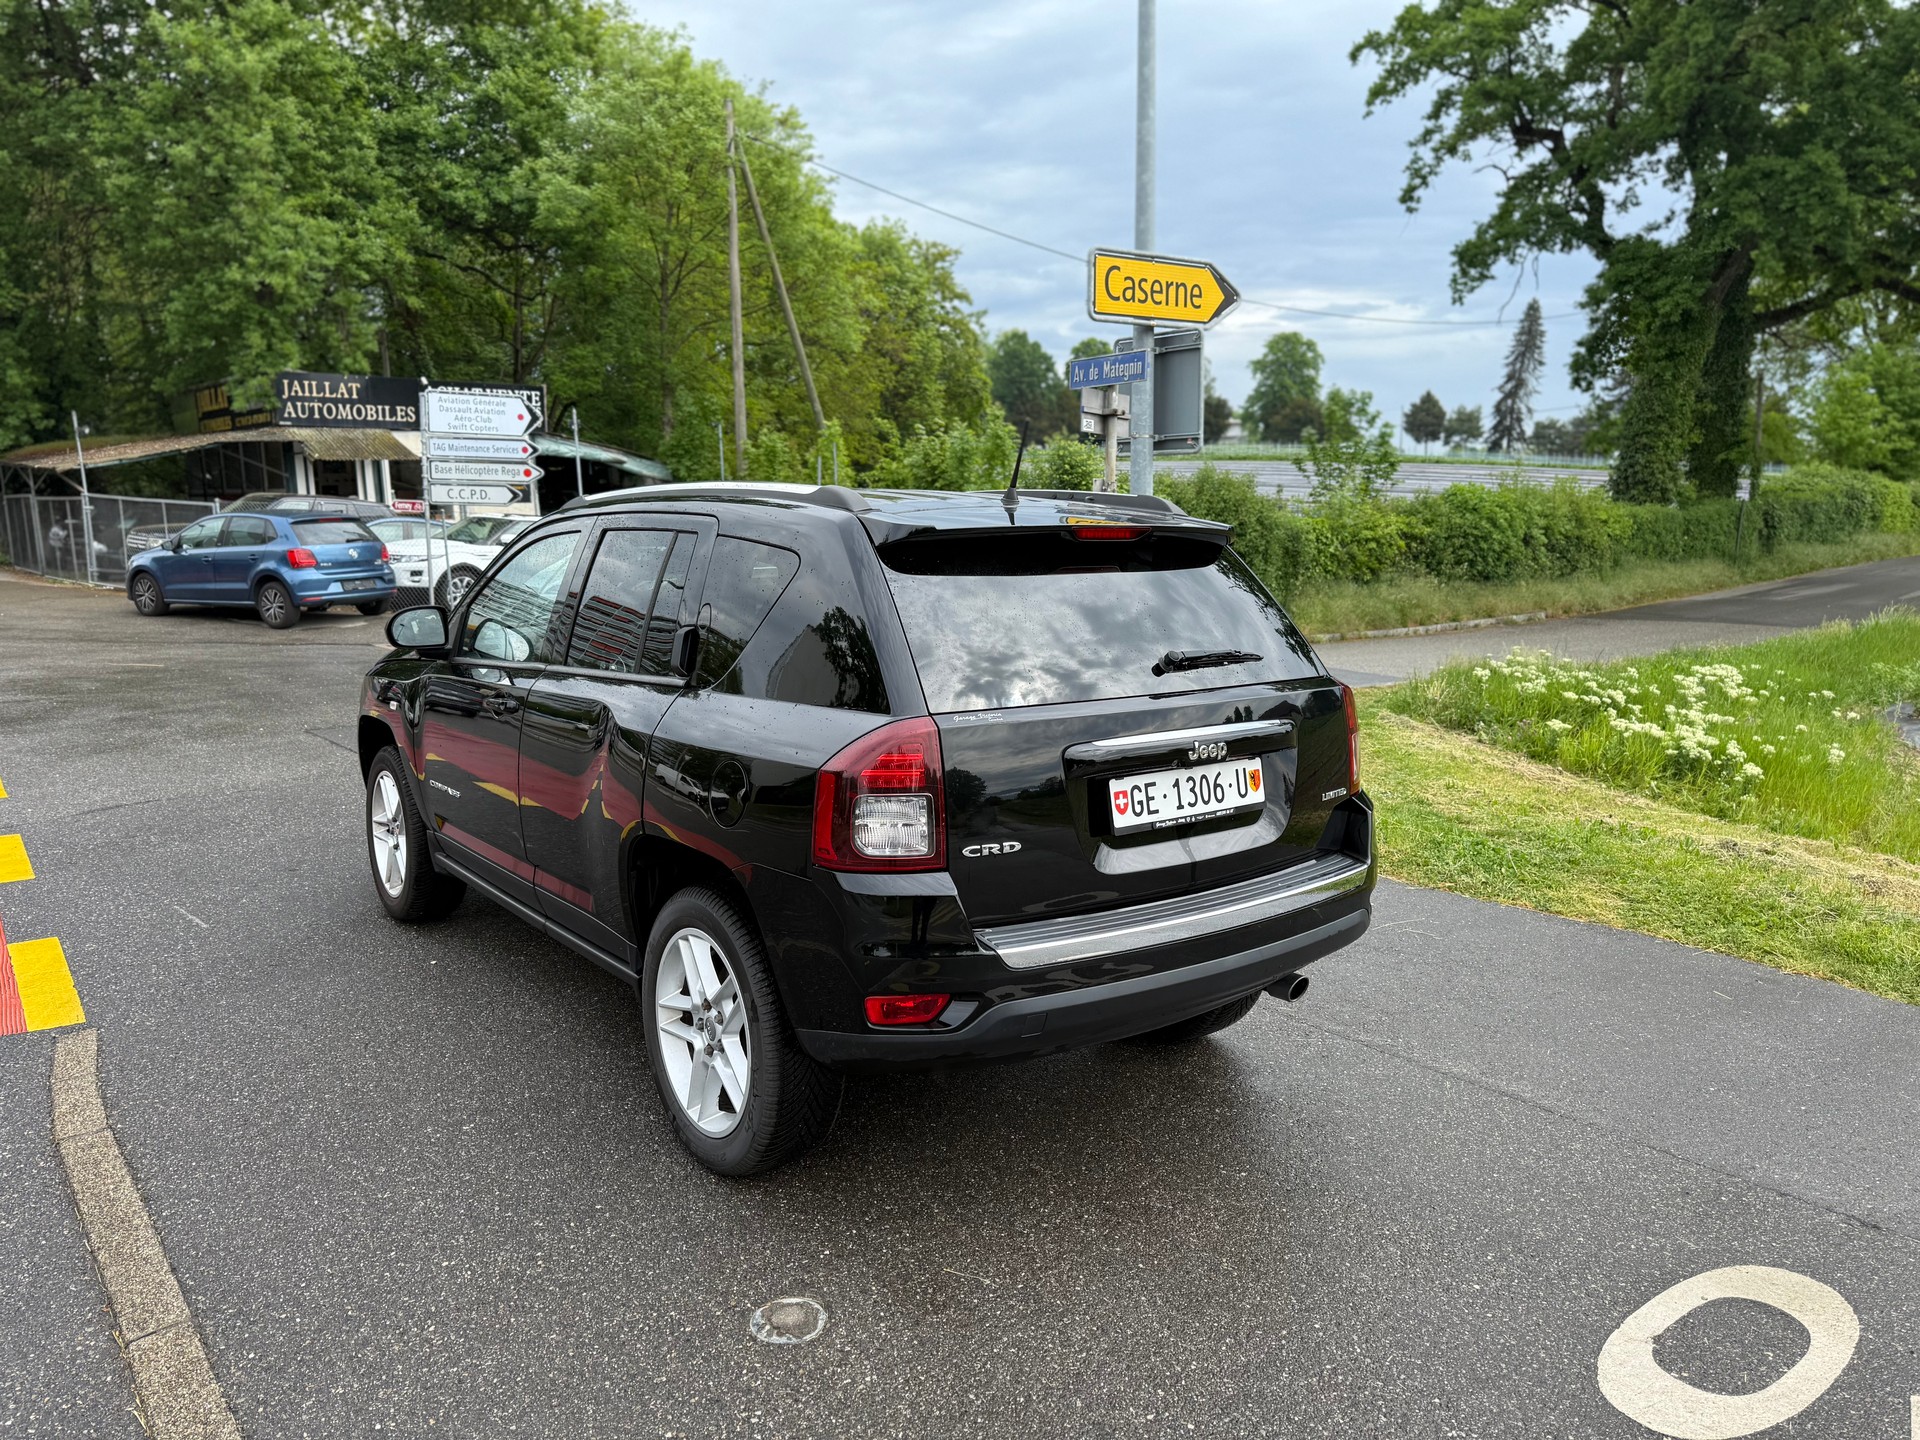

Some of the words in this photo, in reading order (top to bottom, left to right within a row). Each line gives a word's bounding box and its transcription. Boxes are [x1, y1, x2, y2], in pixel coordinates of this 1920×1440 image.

[1104, 265, 1203, 309] Caserne
[1073, 365, 1087, 382] Av.
[1089, 362, 1099, 380] de
[1103, 358, 1142, 381] Mategnin
[282, 379, 360, 399] JAILLAT
[437, 396, 470, 405] Aviation
[472, 397, 507, 407] Générale
[283, 401, 416, 422] AUTOMOBILES
[439, 405, 472, 414] Dassault
[473, 406, 506, 415] Aviation
[454, 414, 493, 424] Aéro-Club
[447, 423, 468, 431] Swift
[469, 424, 499, 433] Copters
[433, 443, 446, 451] TAG
[448, 443, 490, 453] Maintenance
[492, 445, 519, 454] Services
[434, 464, 453, 474] Base
[455, 464, 499, 477] Hélicoptère
[501, 466, 521, 478] Rega
[447, 488, 491, 501] C.C.P.D.
[1188, 741, 1227, 761] Jeep
[962, 841, 1022, 858] CRD
